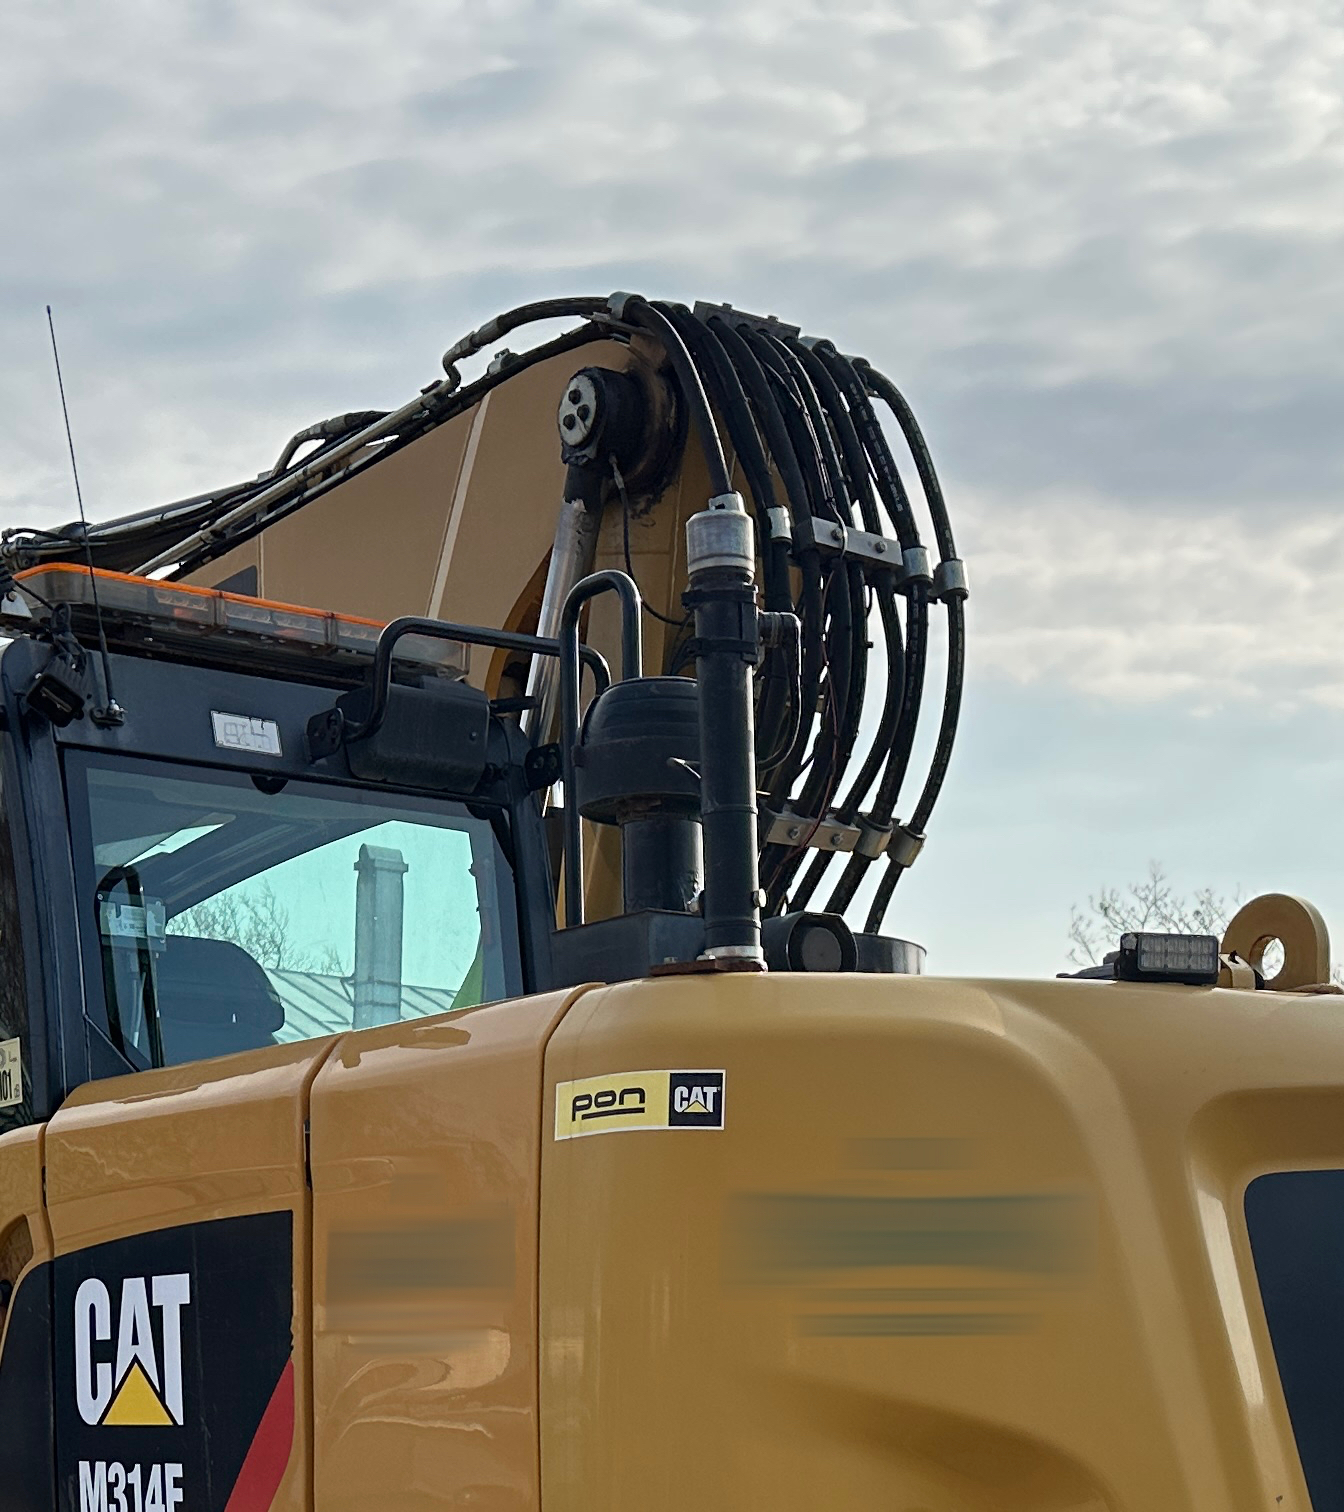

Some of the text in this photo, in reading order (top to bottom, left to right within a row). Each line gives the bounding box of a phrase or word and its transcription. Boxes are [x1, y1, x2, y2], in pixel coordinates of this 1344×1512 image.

[571, 1086, 717, 1122] pon CAT
[74, 1273, 190, 1426] CAT
